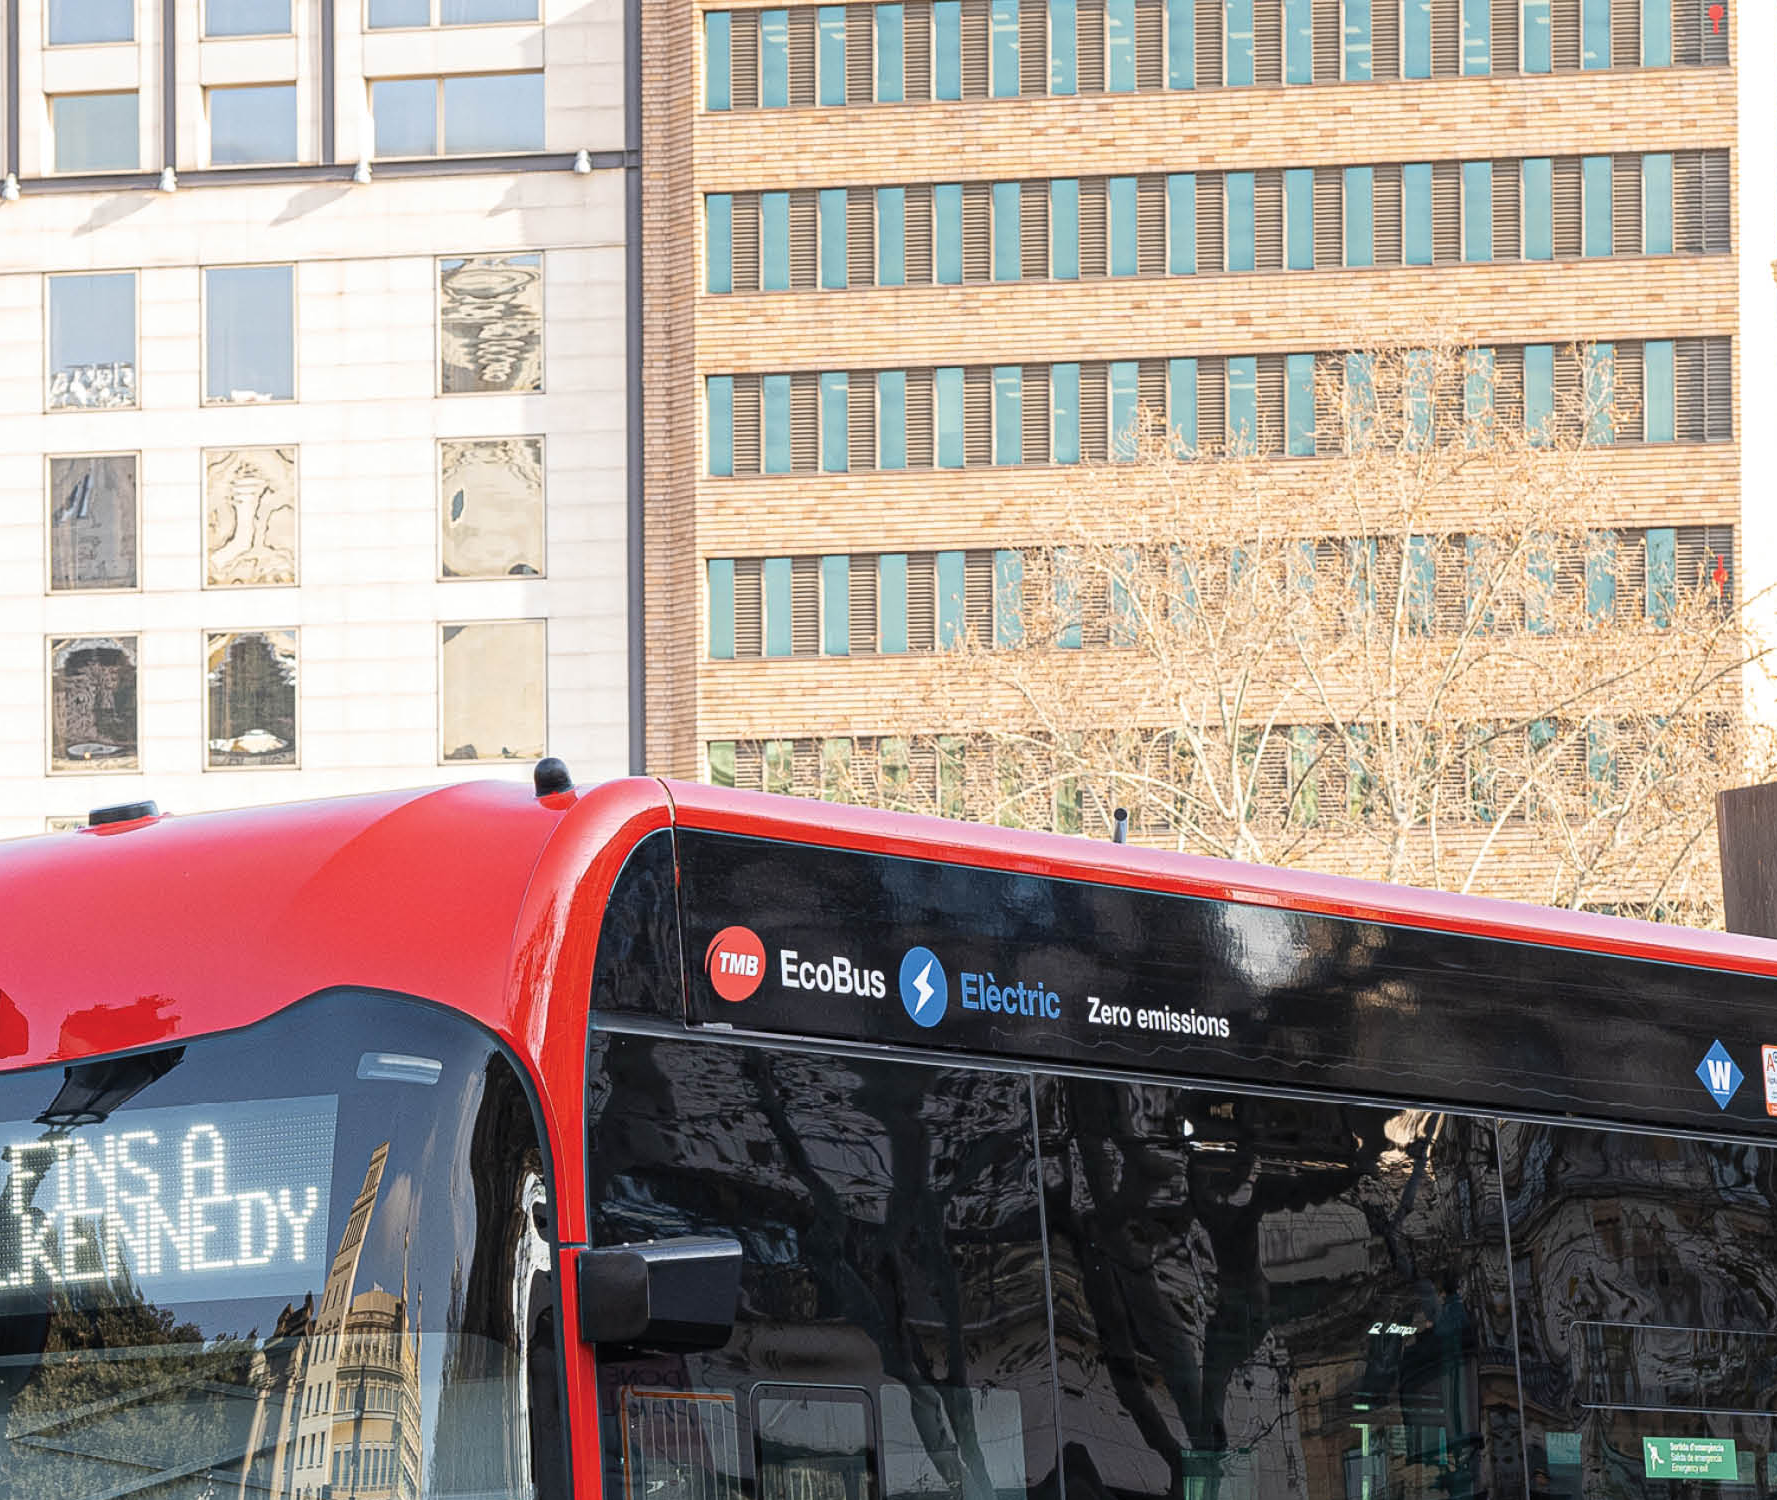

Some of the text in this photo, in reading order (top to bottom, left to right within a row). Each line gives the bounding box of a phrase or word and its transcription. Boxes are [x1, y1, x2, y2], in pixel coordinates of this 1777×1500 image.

[719, 951, 759, 978] TMB
[780, 949, 886, 999] EcoBus
[960, 972, 1062, 1020] Elèctric
[1087, 996, 1230, 1038] Zero emissions
[1707, 1059, 1732, 1091] W
[8, 1124, 225, 1214] FINS A
